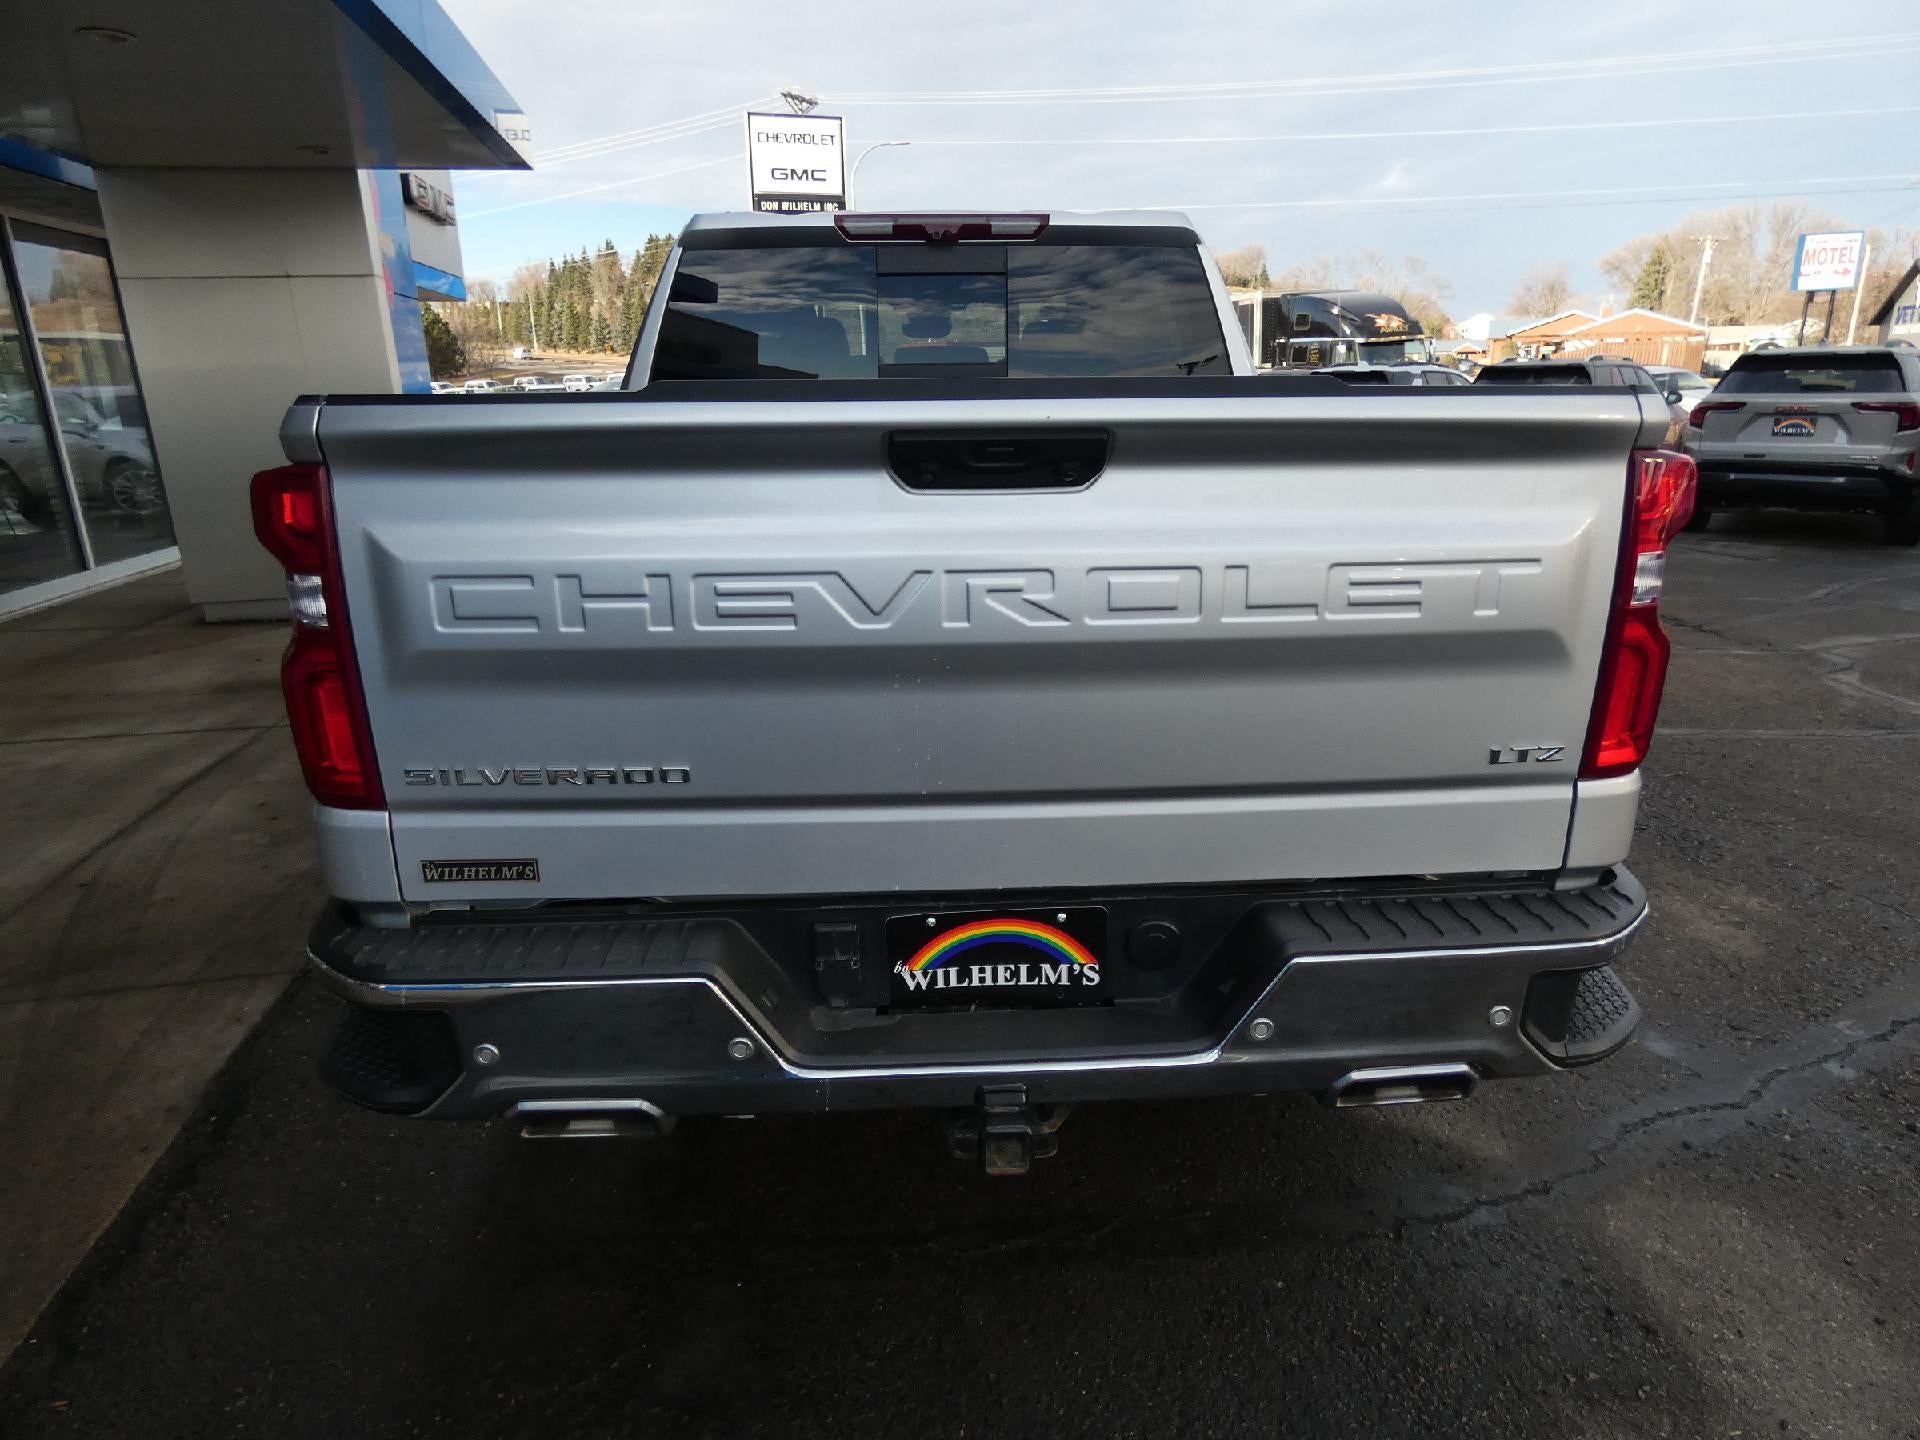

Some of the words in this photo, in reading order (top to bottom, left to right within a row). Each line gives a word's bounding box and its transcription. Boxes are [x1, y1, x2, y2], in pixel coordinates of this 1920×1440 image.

[757, 132, 836, 146] CHEVROLET
[770, 168, 827, 181] GMC
[761, 201, 779, 211] DON
[781, 201, 821, 212] WILHELM
[824, 202, 839, 212] INC
[1803, 247, 1856, 266] MOTEL
[430, 558, 1542, 635] CHEVROLET
[1489, 745, 1565, 764] LTZ
[404, 767, 691, 786] SILVERADO
[425, 866, 534, 880] WILHELM'S
[902, 962, 1100, 991] WILHELM'S
